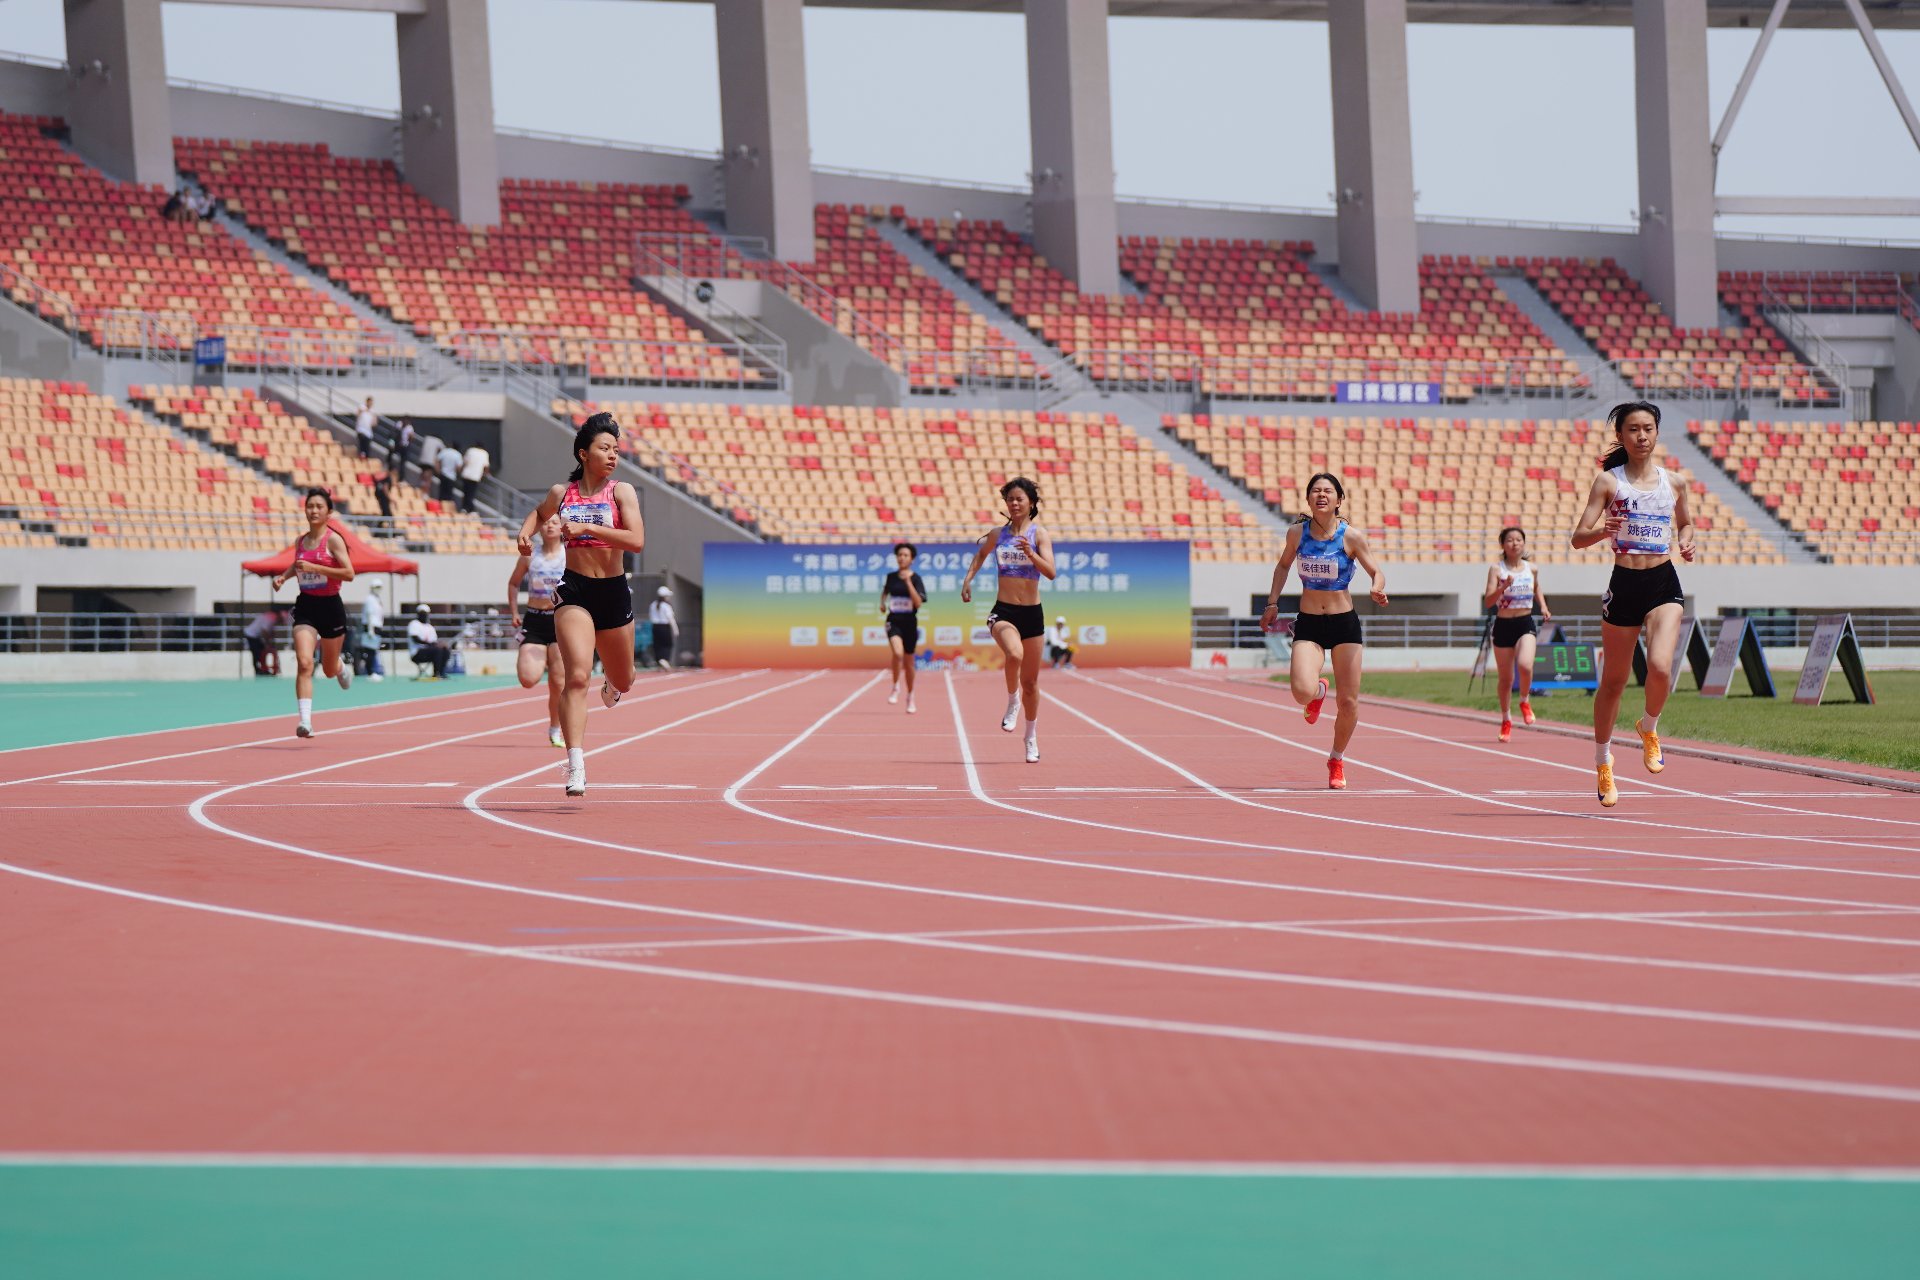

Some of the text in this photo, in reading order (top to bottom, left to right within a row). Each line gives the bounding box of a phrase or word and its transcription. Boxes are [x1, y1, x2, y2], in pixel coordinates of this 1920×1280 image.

[1628, 523, 1662, 537] 姚睿欣
[1302, 562, 1331, 574] 侯佳琪
